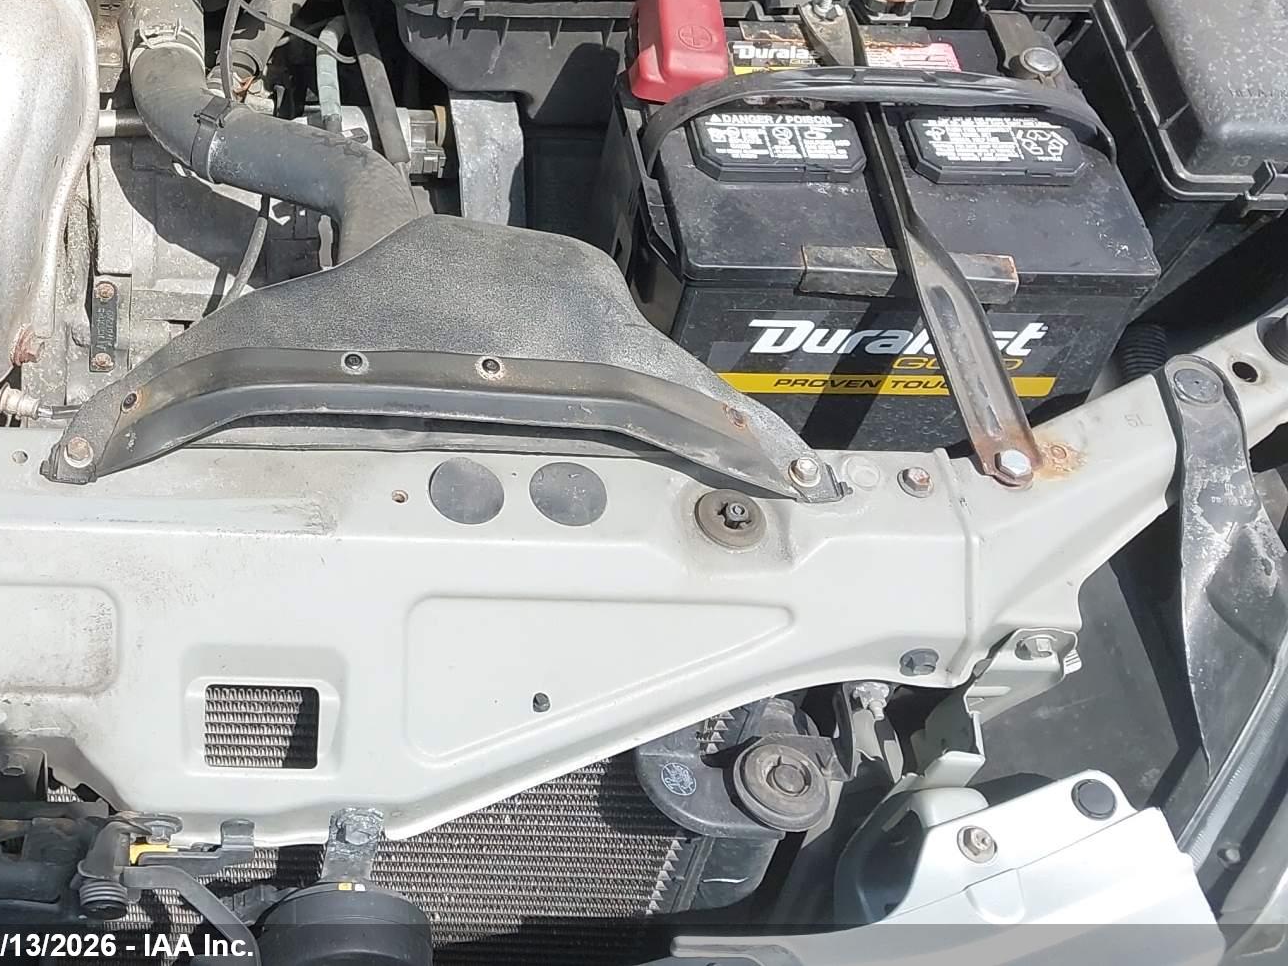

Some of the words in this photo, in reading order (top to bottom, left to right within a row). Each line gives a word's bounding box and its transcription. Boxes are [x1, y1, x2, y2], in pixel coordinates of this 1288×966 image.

[721, 114, 774, 125] DANGER
[785, 115, 833, 125] POISON
[774, 378, 883, 389] PROVEN
[891, 380, 950, 389] TOU
